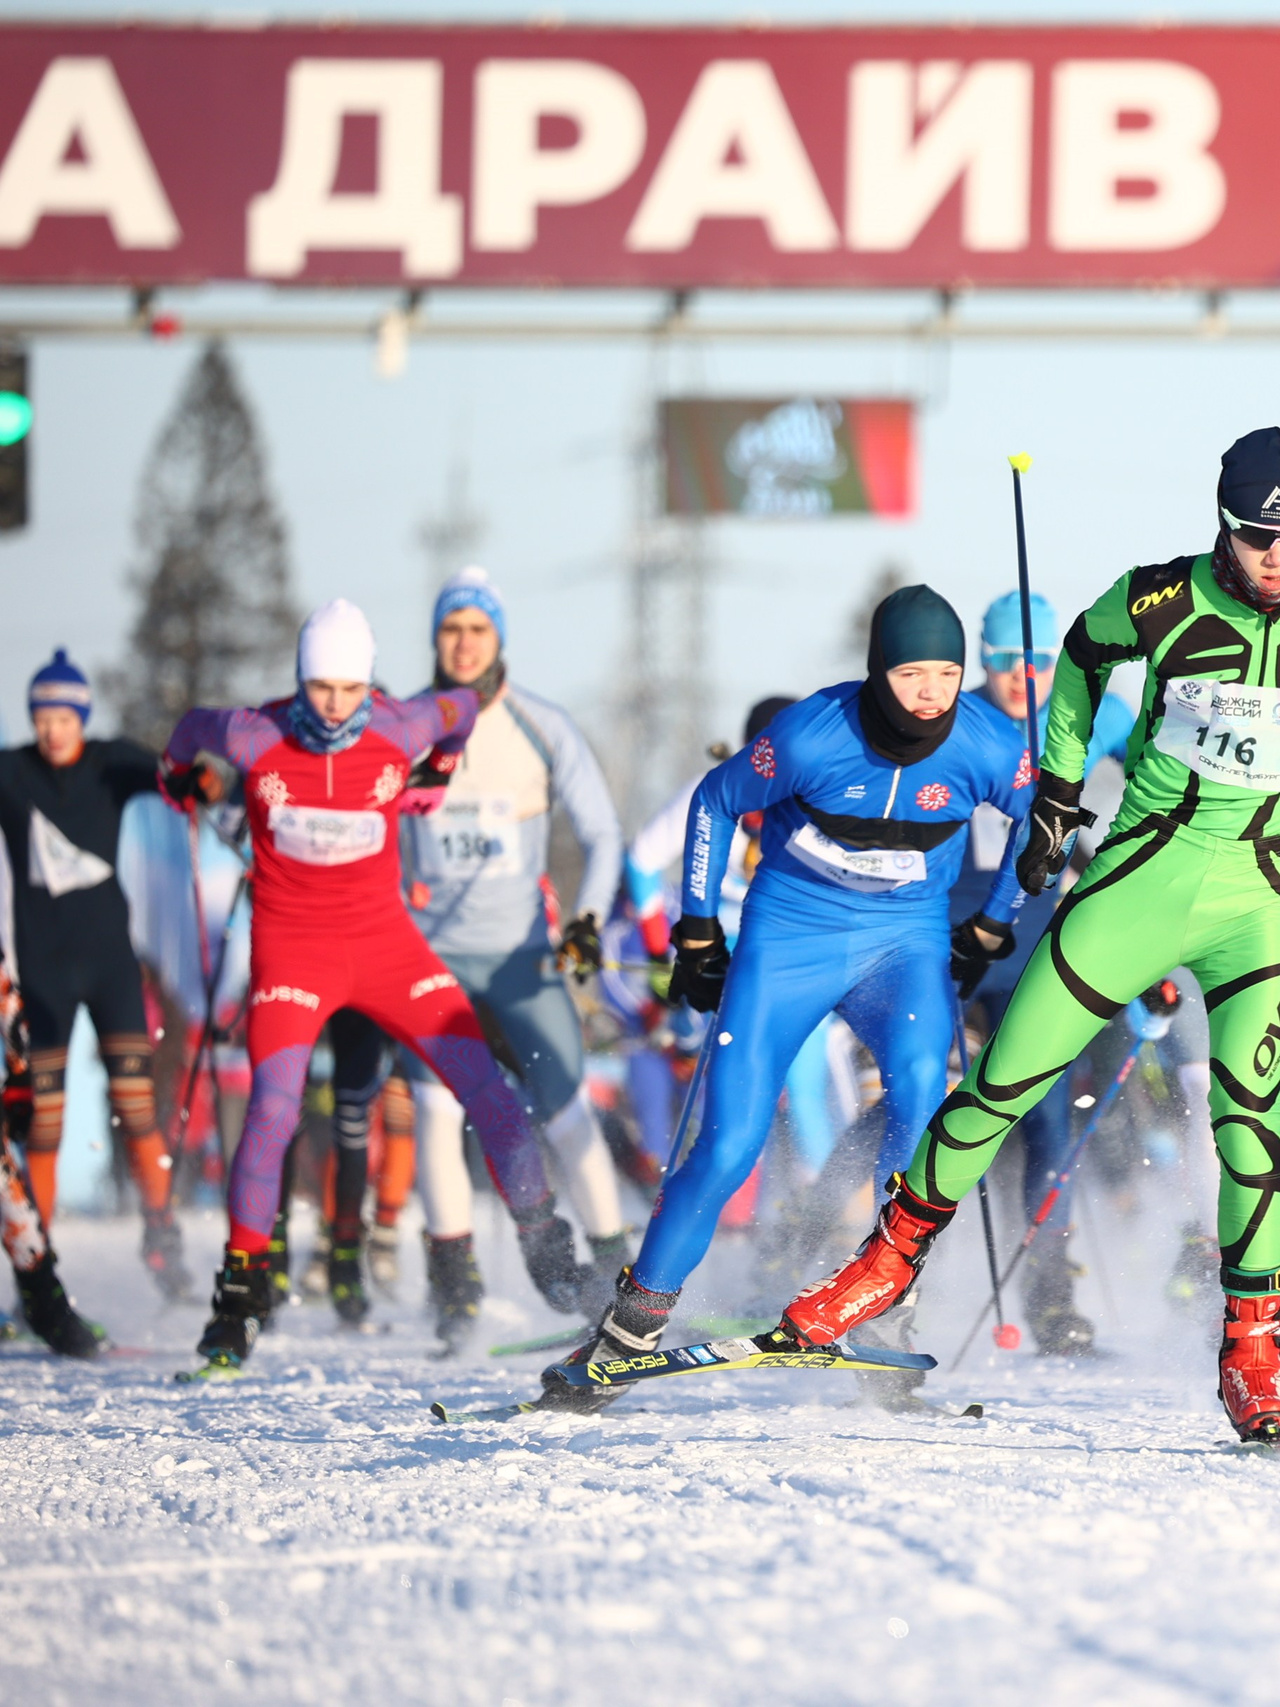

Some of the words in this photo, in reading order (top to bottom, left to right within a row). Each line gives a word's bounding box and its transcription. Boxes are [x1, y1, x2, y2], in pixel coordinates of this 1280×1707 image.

[245, 57, 1228, 278] ДРАЙВ
[1131, 580, 1184, 616] OW
[1195, 725, 1257, 767] 116
[1198, 754, 1280, 780] САНКТ-ПЕТЕРБУРГ
[838, 1280, 896, 1324] alpina
[602, 1352, 670, 1376] FISCHER
[755, 1353, 838, 1369] FISCHER
